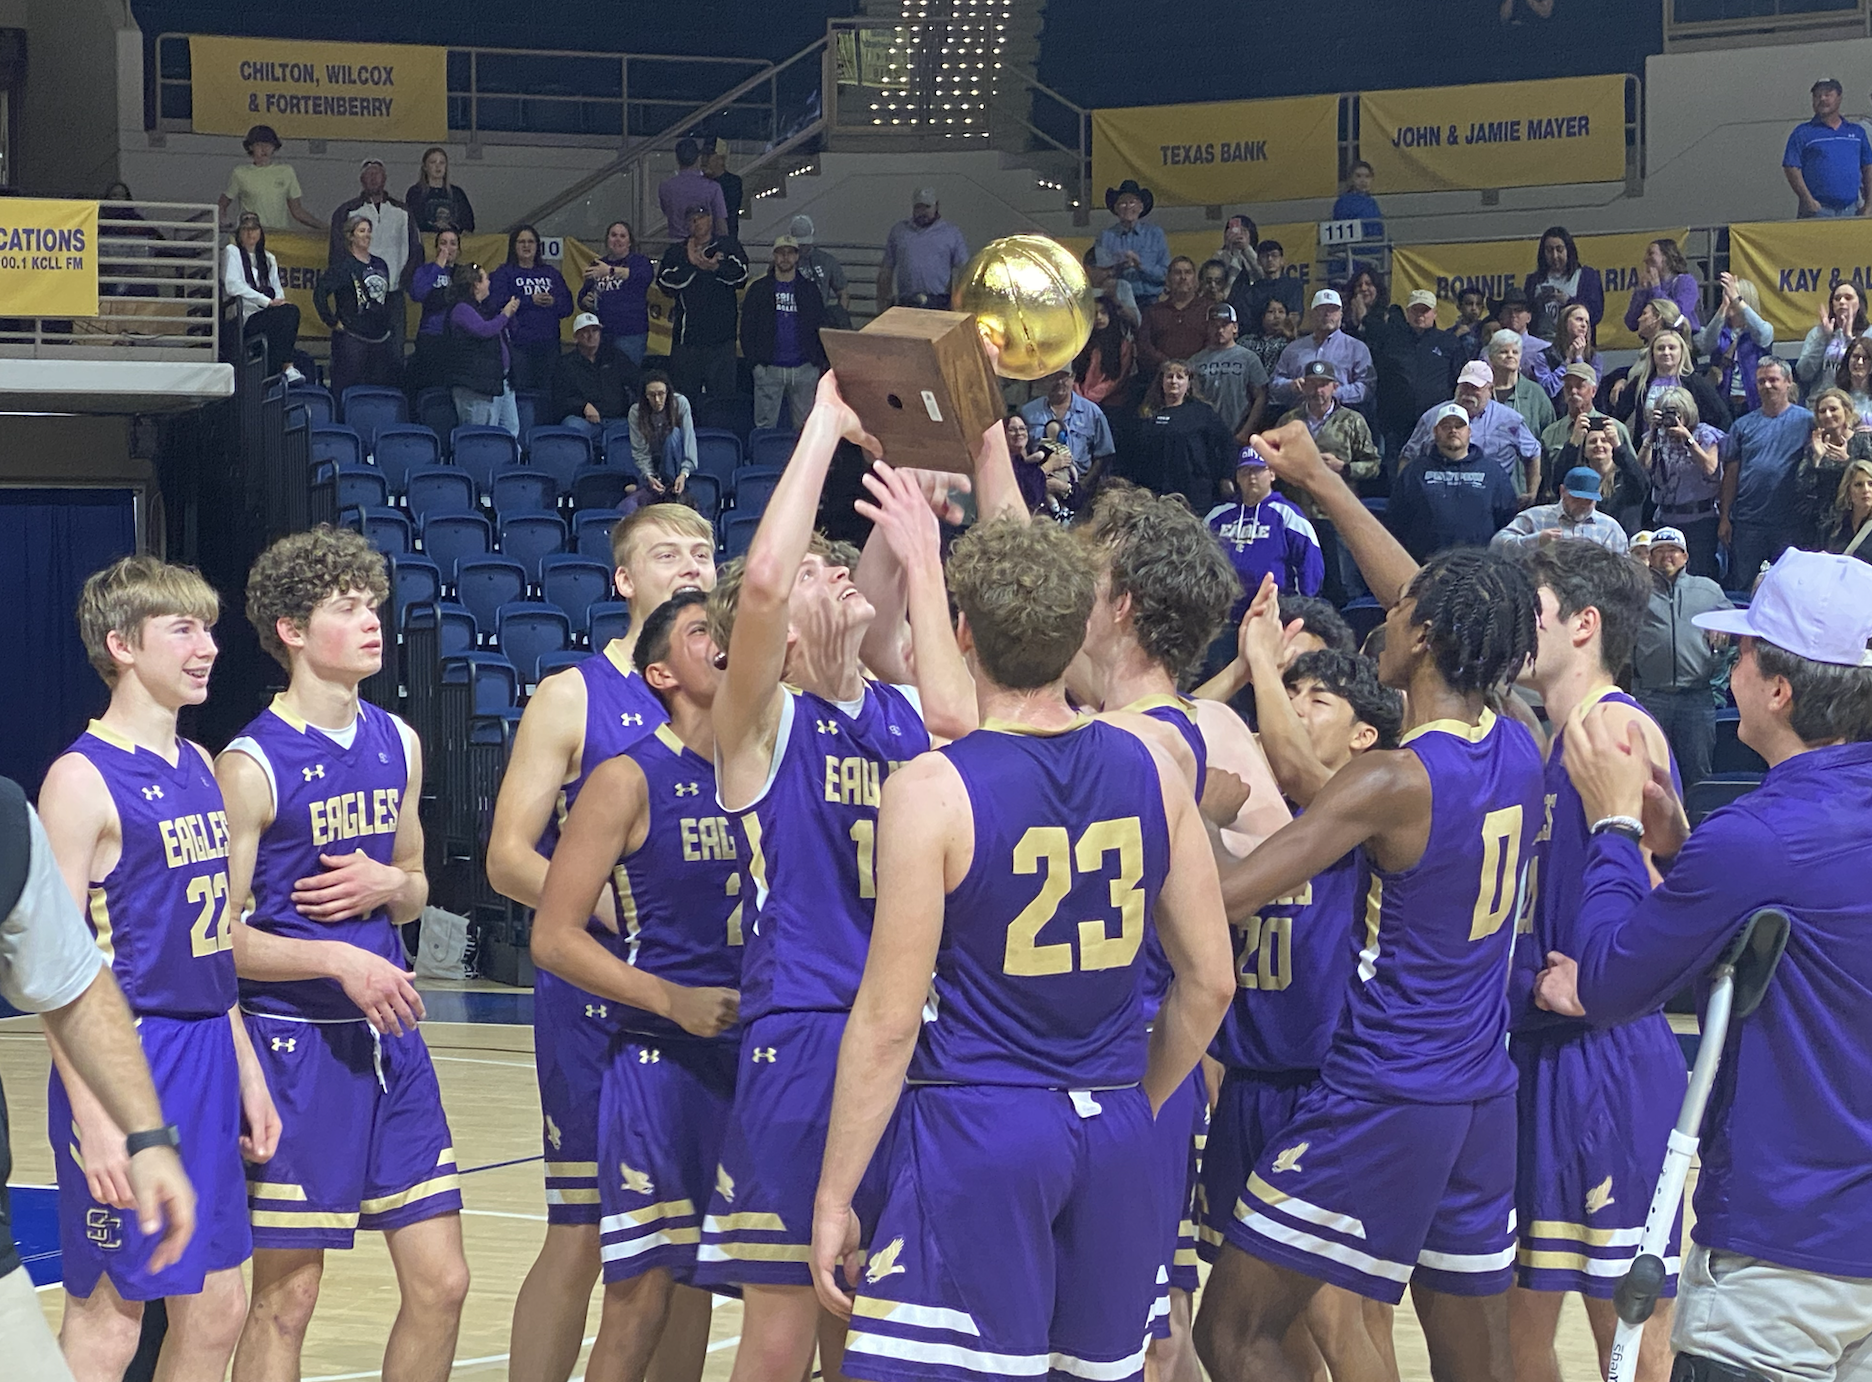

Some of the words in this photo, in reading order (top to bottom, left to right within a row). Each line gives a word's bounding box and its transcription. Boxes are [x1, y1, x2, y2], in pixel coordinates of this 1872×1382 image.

[239, 61, 320, 87] CHILTON,
[326, 65, 394, 86] WILCOX
[249, 93, 260, 112] &
[265, 94, 394, 117] FORTENBERRY
[1391, 126, 1441, 148] JOHN
[1447, 125, 1459, 146] &
[1465, 120, 1521, 145] JAMIE
[1527, 115, 1590, 141] MAYER
[1160, 143, 1215, 166] TEXAS
[1220, 140, 1268, 163] BANK
[0, 227, 86, 252] CATIONS
[1325, 224, 1356, 240] 111
[31, 256, 62, 270] KCLL
[66, 257, 84, 270] FM
[1779, 268, 1822, 292] KAY
[309, 788, 398, 846] EAGLES
[159, 811, 231, 869] EAGLES
[1003, 816, 1146, 976] 23
[186, 871, 234, 958] 22
[1237, 915, 1293, 991] 20
